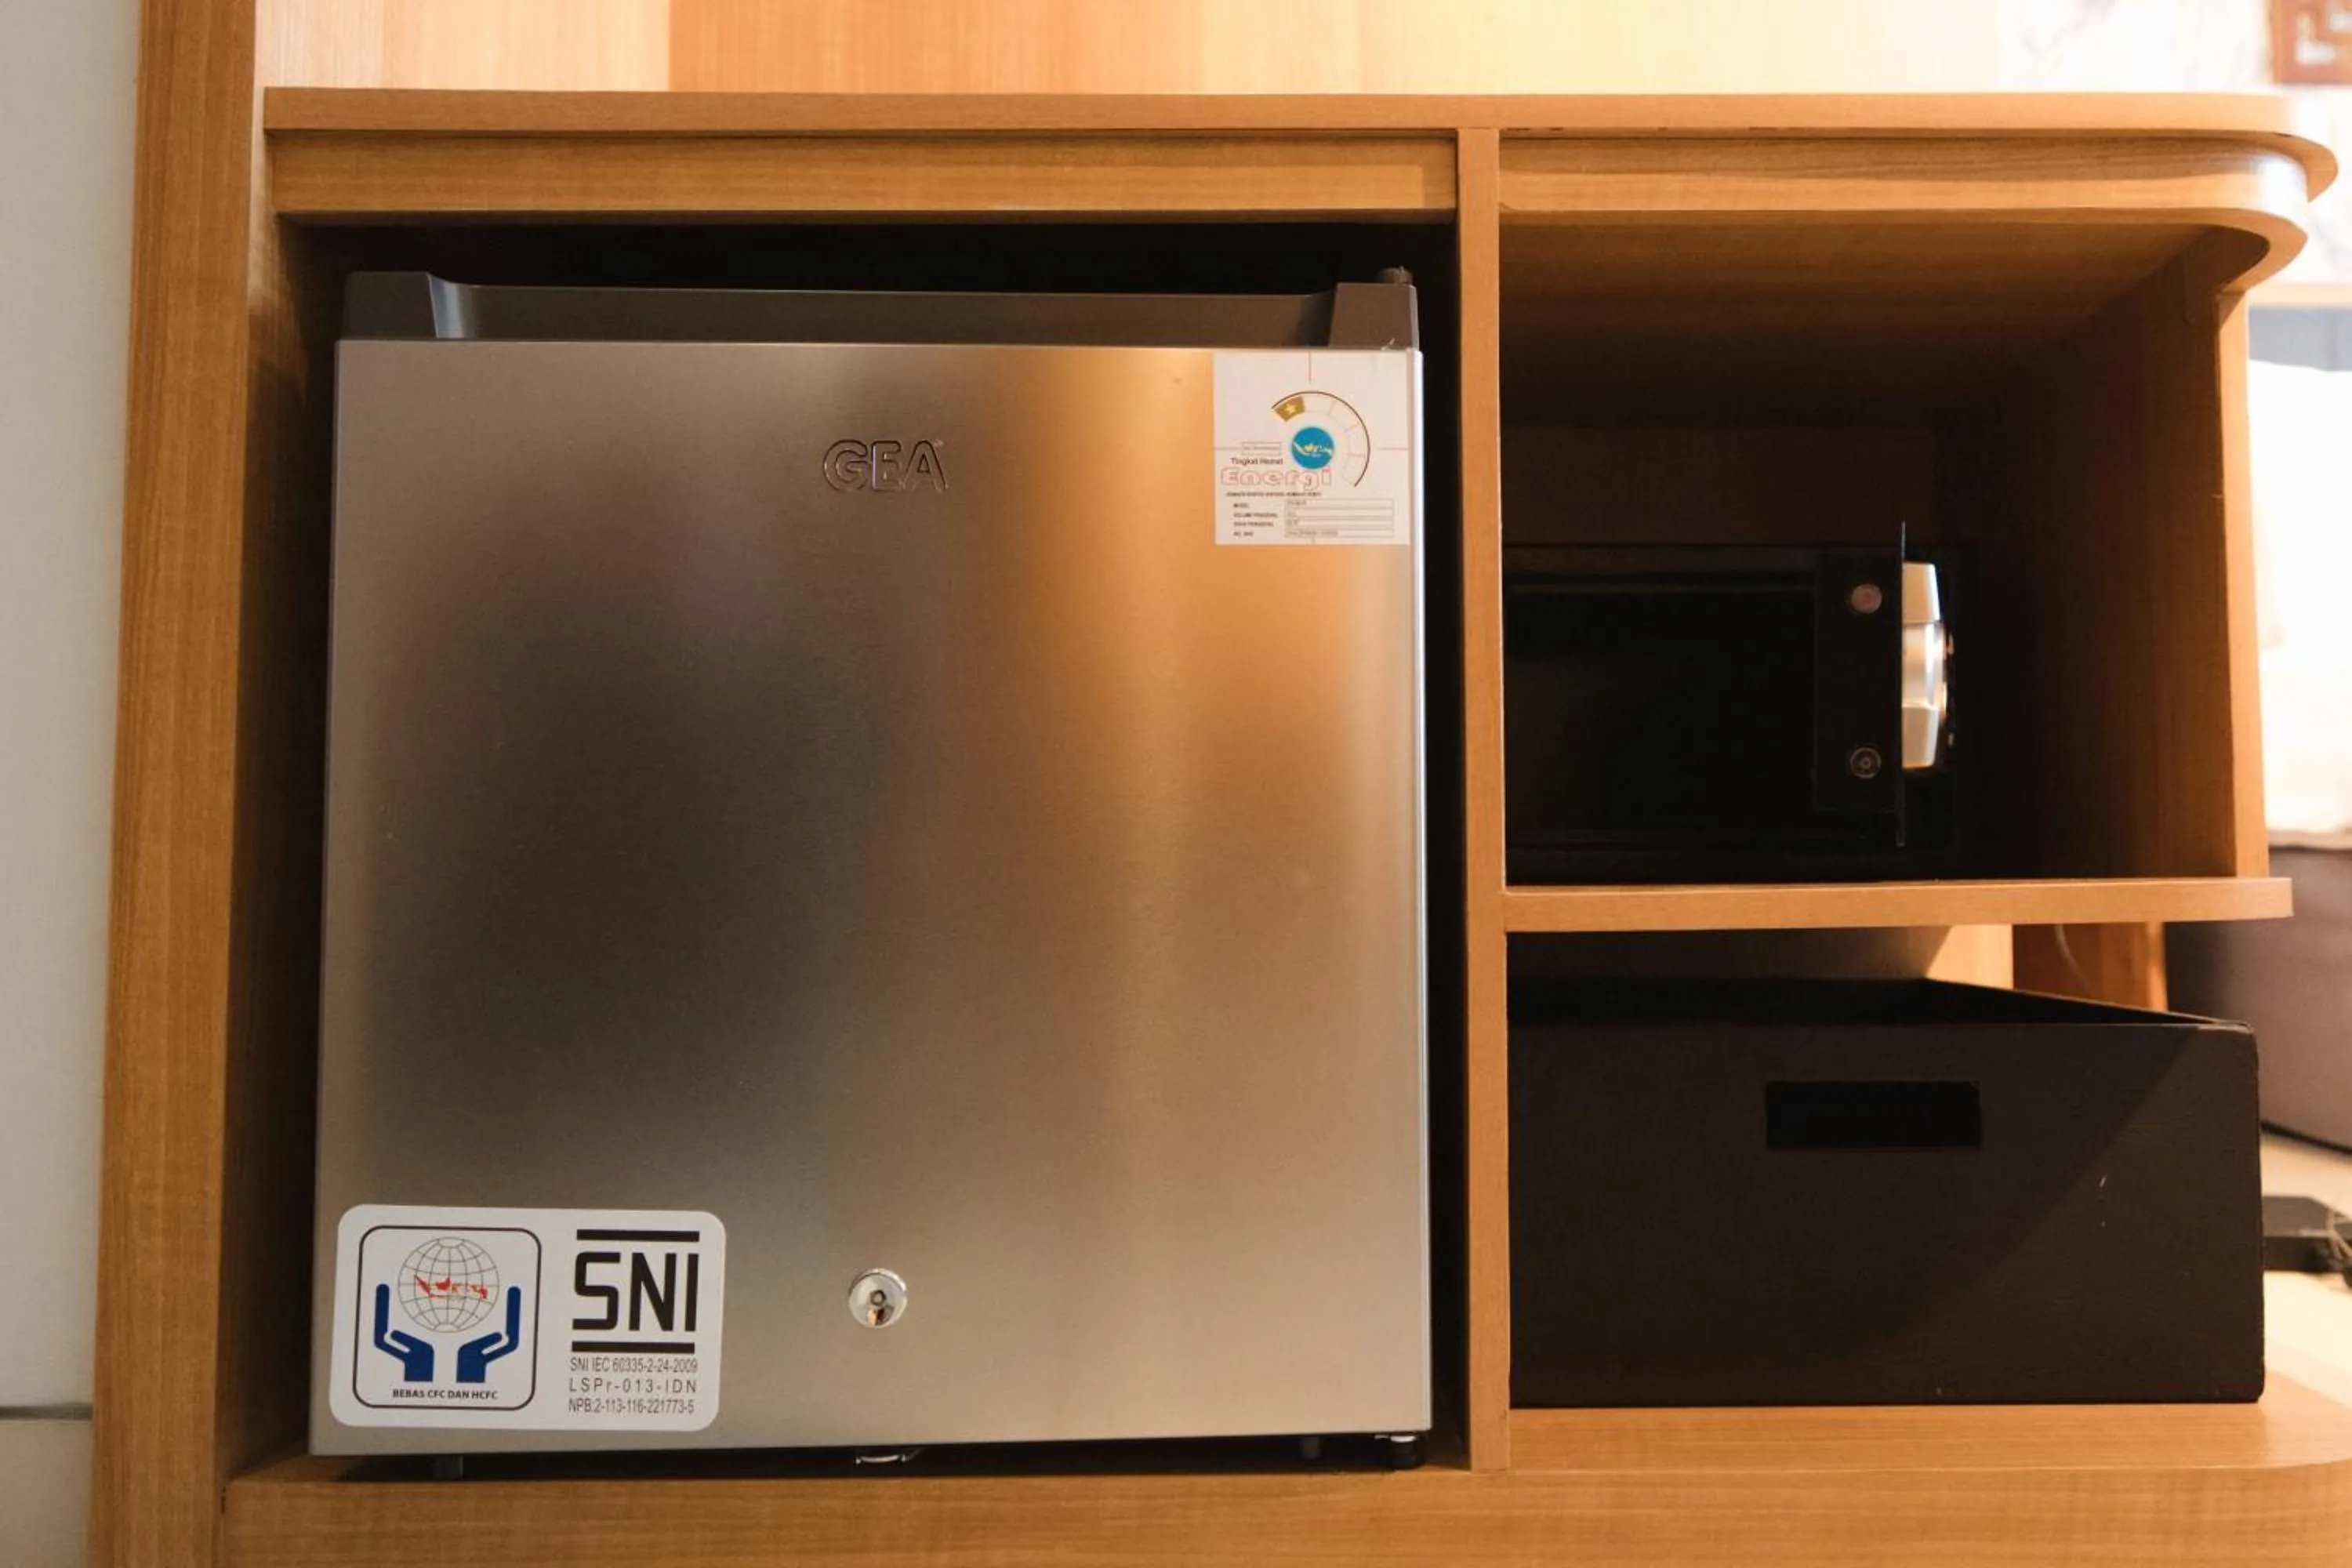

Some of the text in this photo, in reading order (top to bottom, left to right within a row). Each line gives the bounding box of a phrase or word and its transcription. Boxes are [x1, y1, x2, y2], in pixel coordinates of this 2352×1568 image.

[822, 439, 949, 492] GEA
[1221, 468, 1332, 491] Energi
[572, 1252, 699, 1331] SNI
[570, 1357, 698, 1374] SNI IEC 60335-2-24-2009
[393, 1388, 498, 1399] BEBAS CFC DAN HCFC
